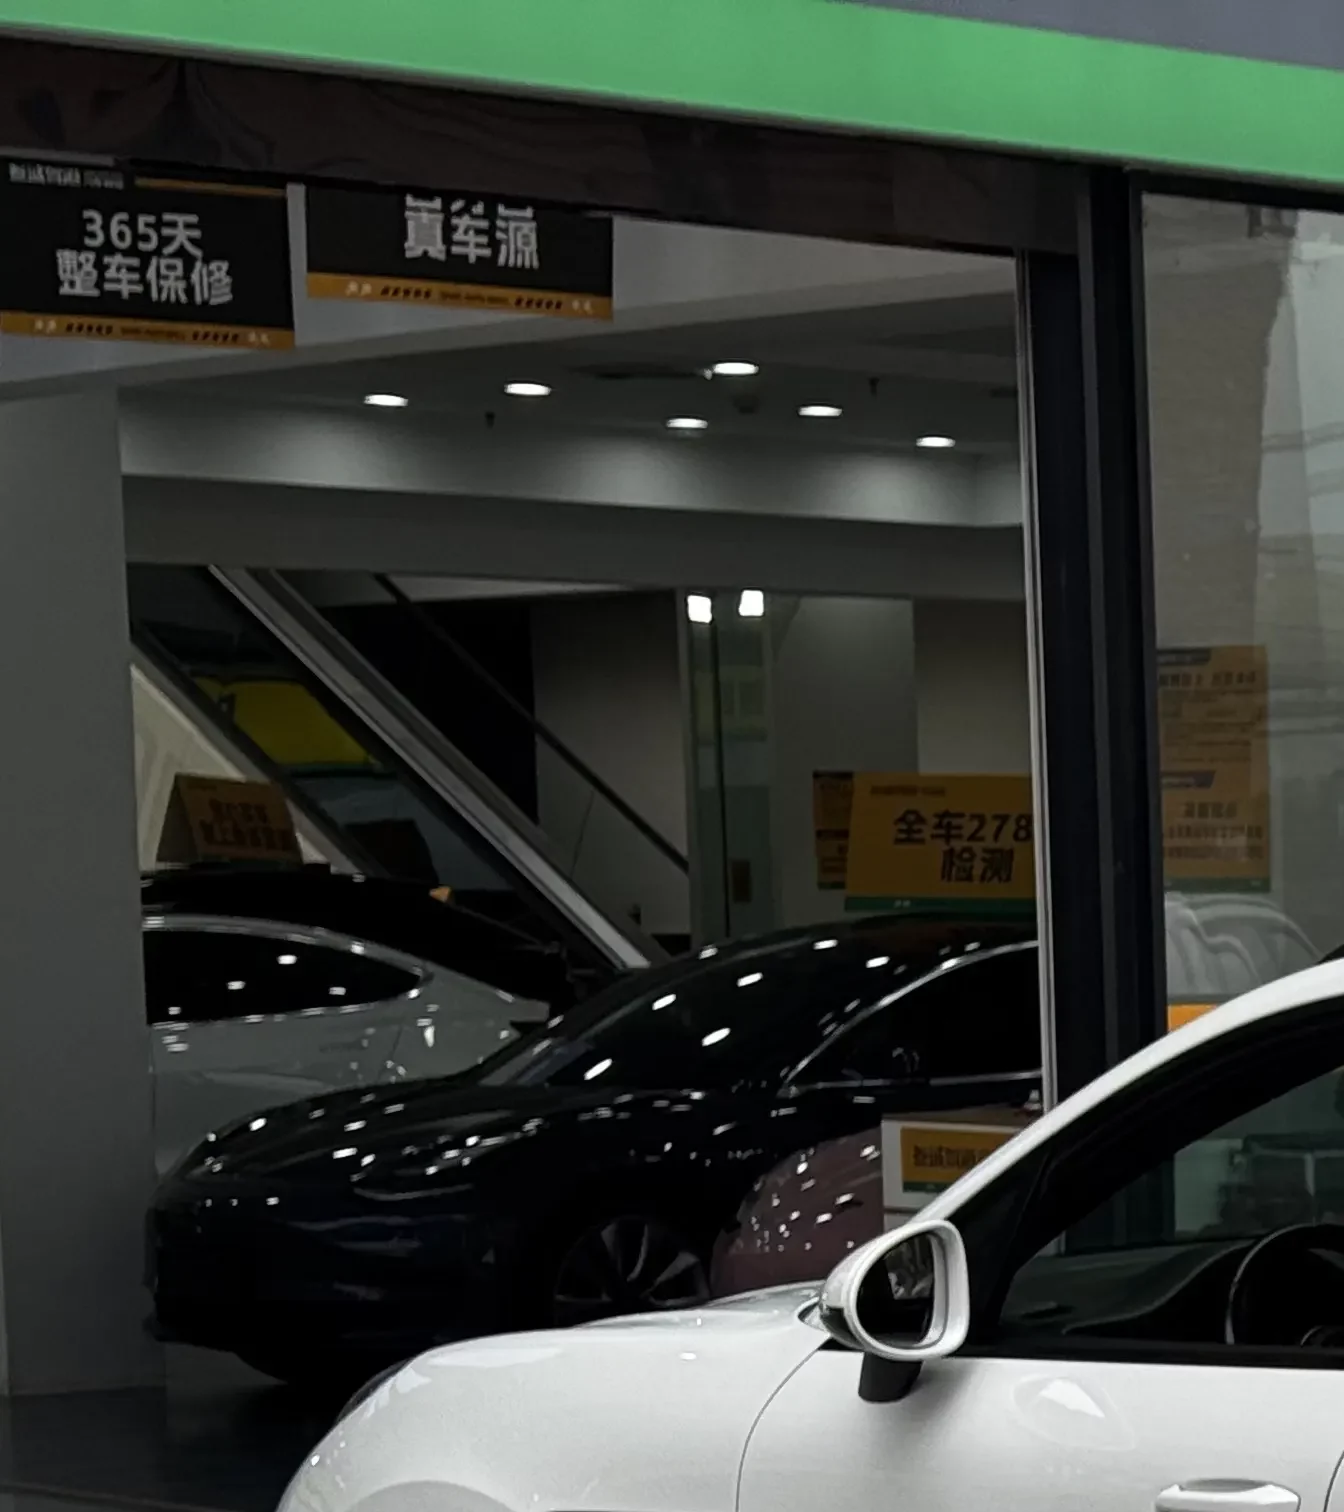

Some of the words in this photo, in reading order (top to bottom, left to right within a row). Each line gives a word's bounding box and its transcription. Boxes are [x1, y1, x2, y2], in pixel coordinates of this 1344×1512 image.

[82, 208, 204, 258] 365天
[55, 248, 234, 305] 整车保修
[893, 808, 1033, 846] 全车278
[940, 847, 1014, 884] 检测
